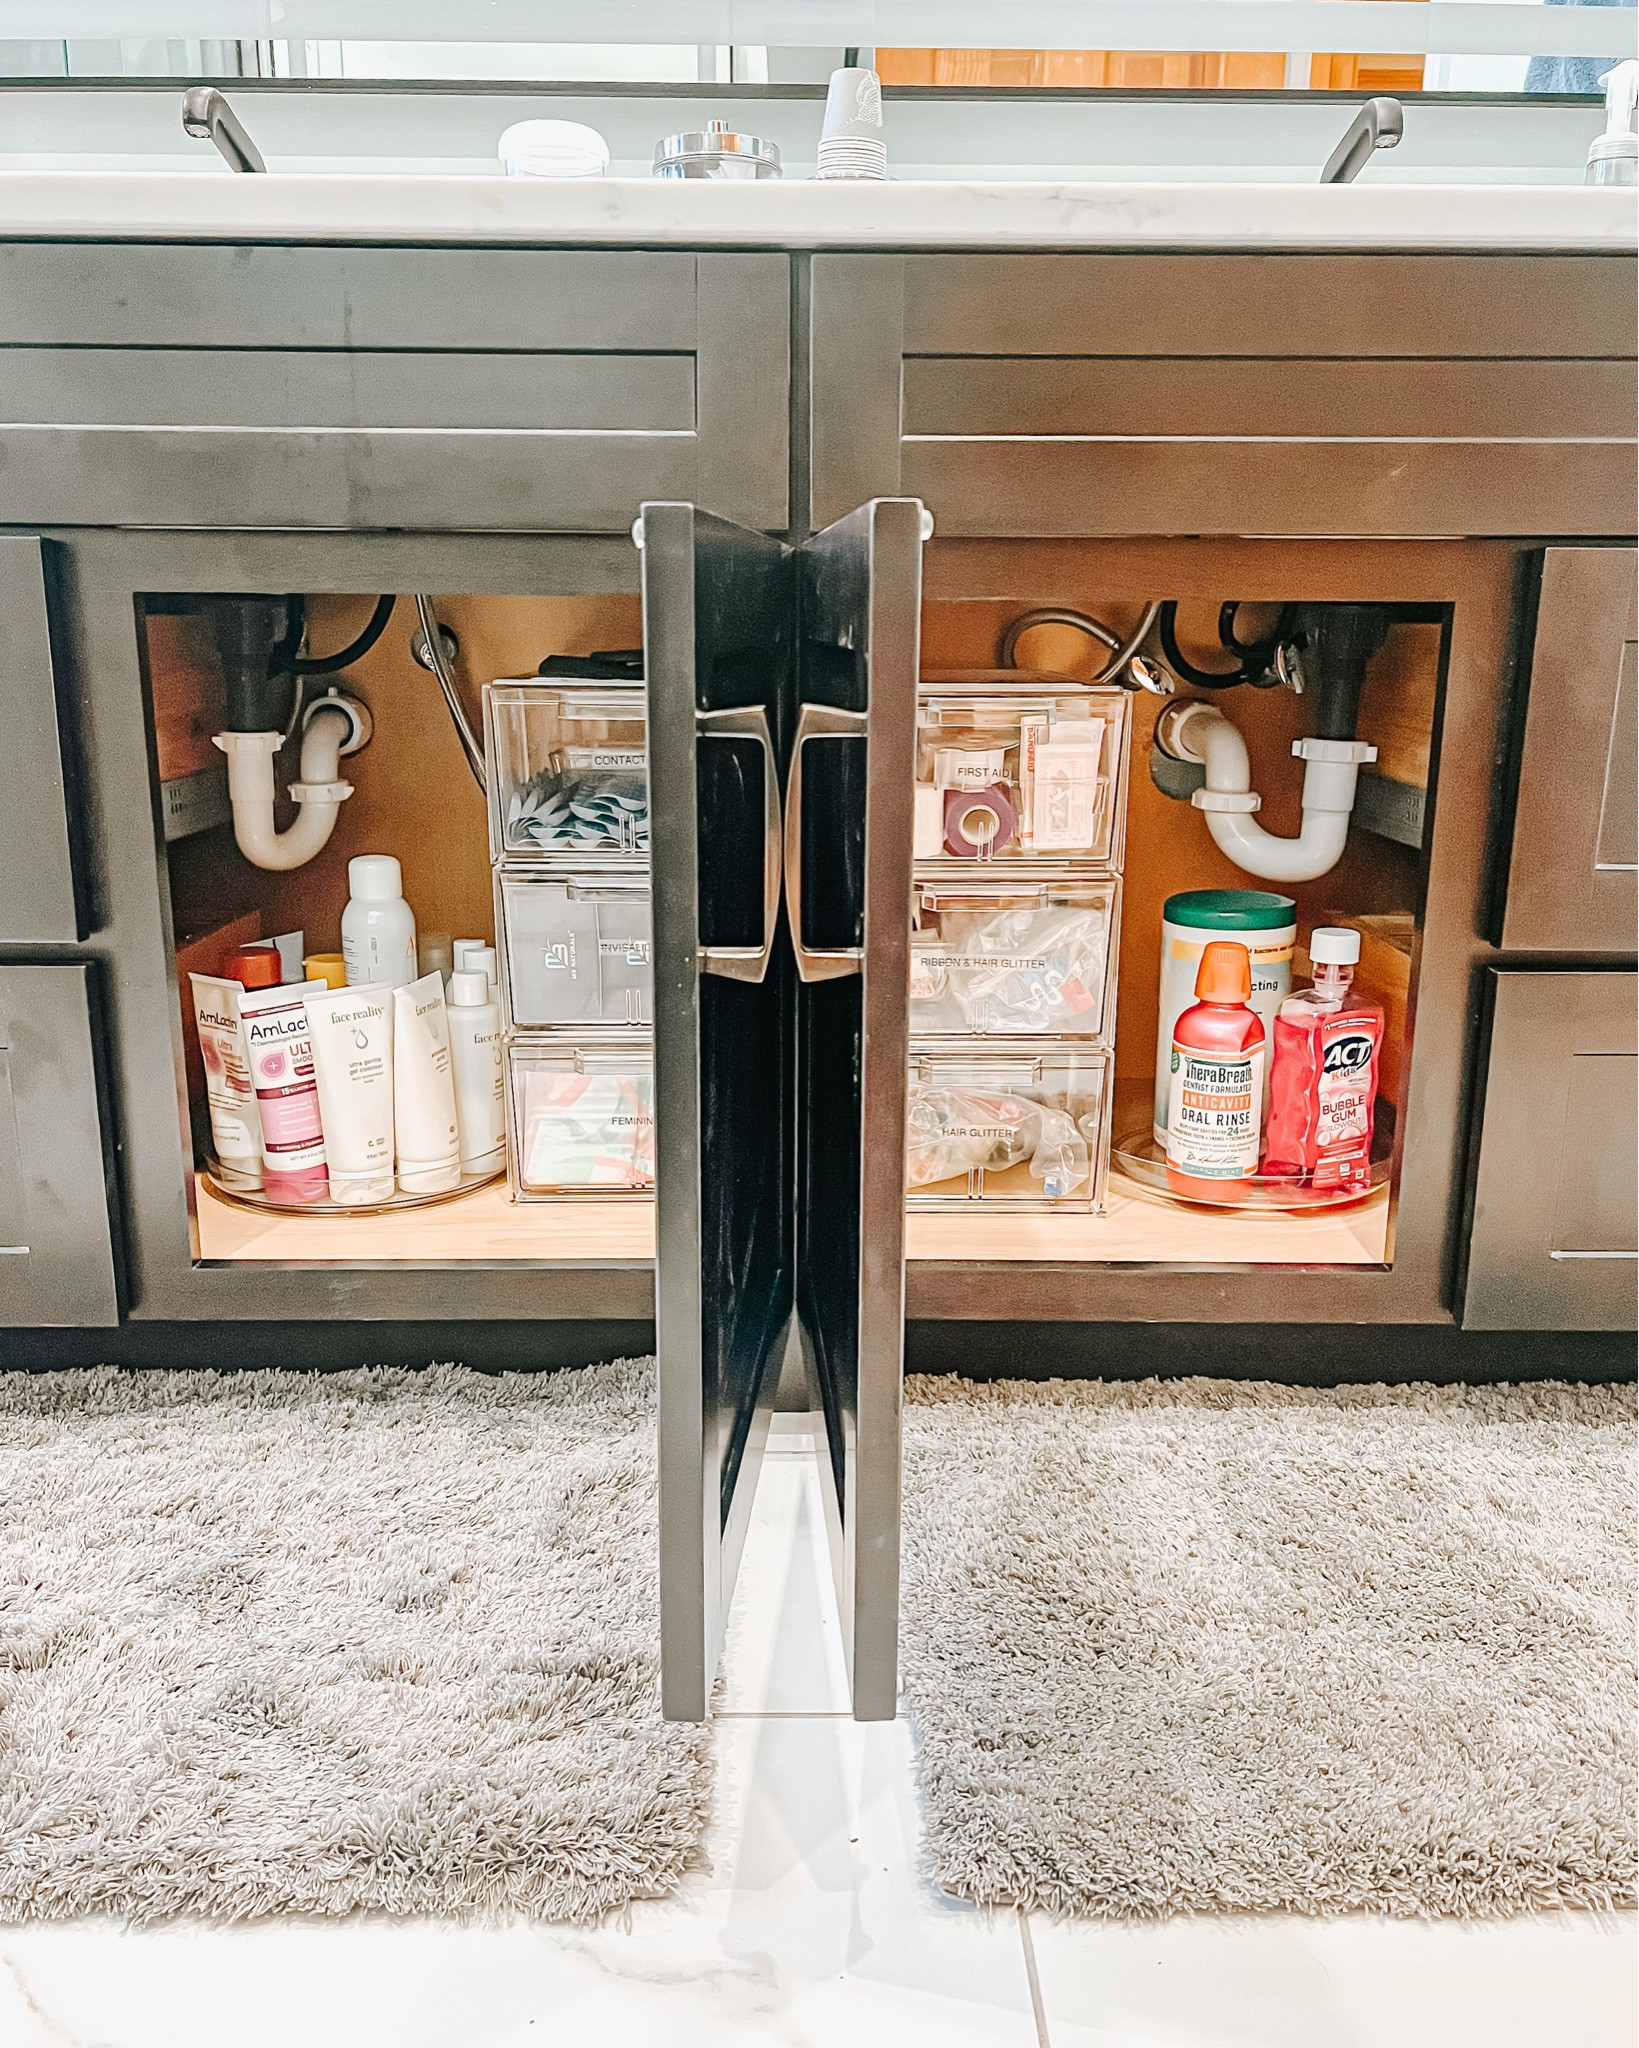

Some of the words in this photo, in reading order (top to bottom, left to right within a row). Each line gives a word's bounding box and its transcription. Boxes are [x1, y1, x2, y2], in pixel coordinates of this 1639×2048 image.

[957, 767, 989, 778] FIRST
[991, 768, 1010, 778] AID
[921, 956, 961, 967] RIBBON
[963, 958, 970, 967] &
[973, 958, 998, 968] HAIR
[1000, 958, 1045, 969] GLITTER
[331, 1012, 351, 1024] face
[474, 1033, 493, 1044] face
[1324, 1041, 1370, 1067] ACT
[1183, 1080, 1209, 1091] DENTIST
[1211, 1083, 1252, 1093] FORMULATED
[1184, 1092, 1250, 1110] ANTICAVITY
[1323, 1095, 1365, 1115] BUBBLE
[1182, 1107, 1210, 1125] ORAL
[1216, 1111, 1250, 1126] RINSE
[1331, 1108, 1356, 1123] GUM
[942, 1128, 967, 1137] HAIR
[969, 1128, 1013, 1138] GLITTER
[1227, 1126, 1239, 1136] 24
